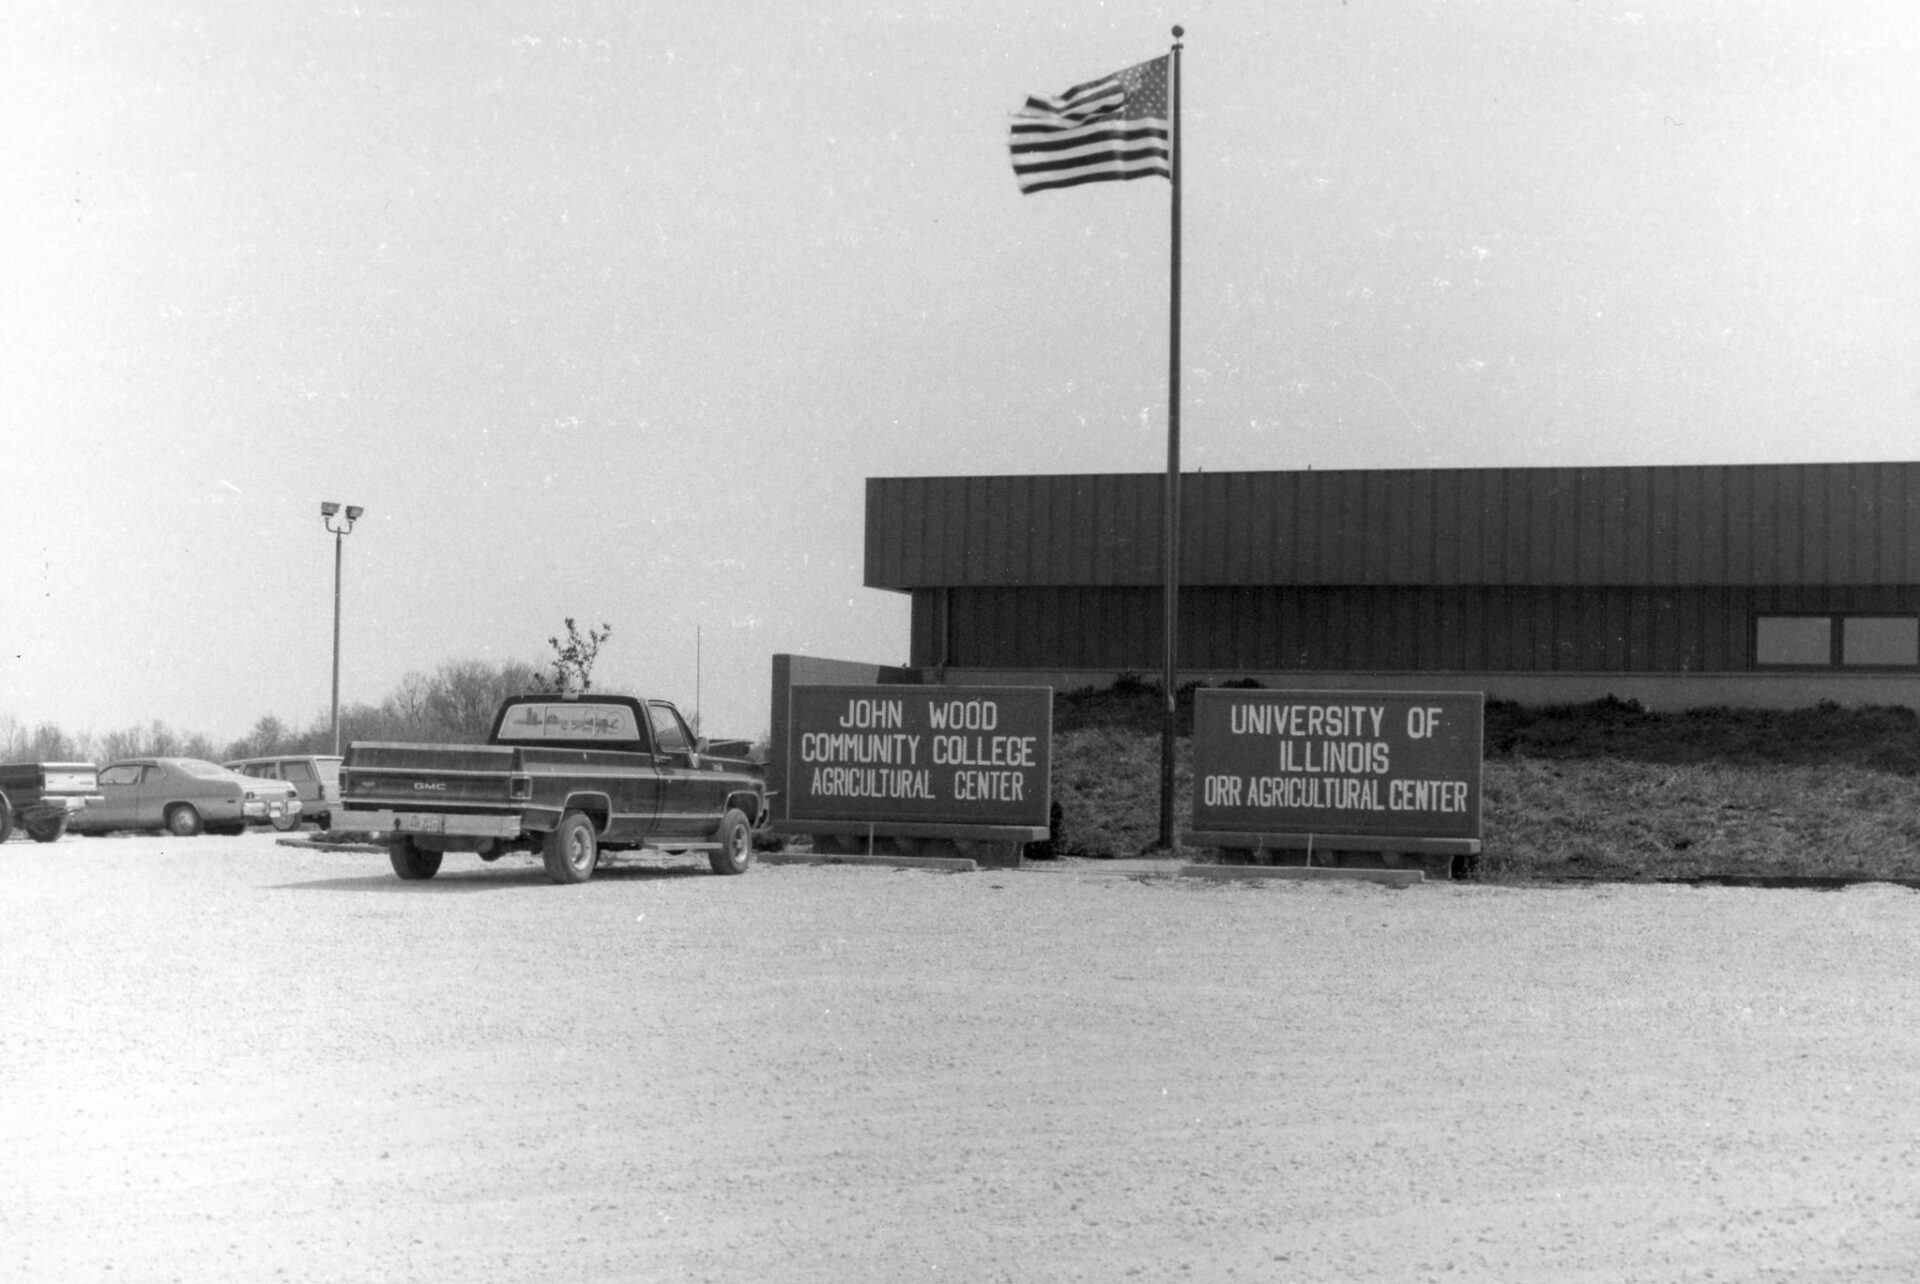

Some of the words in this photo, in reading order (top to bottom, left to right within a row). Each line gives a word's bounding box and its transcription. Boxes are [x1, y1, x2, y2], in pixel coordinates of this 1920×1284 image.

[840, 699, 902, 729] JOHN
[929, 700, 998, 731] WOOD
[1231, 704, 1384, 737] UNIVERSITY
[1407, 706, 1443, 739] OF
[801, 732, 920, 765] COMMUNITY
[932, 735, 1037, 767] COLLEGE
[1280, 740, 1390, 774] ILLINOIS
[413, 782, 447, 791] GMC
[811, 767, 936, 799] AGRICULTURAL
[954, 770, 1024, 801] CENTER
[1204, 775, 1242, 807] ORR
[1247, 776, 1385, 811] AGRICULTURAL
[1389, 779, 1468, 813] CENTER
